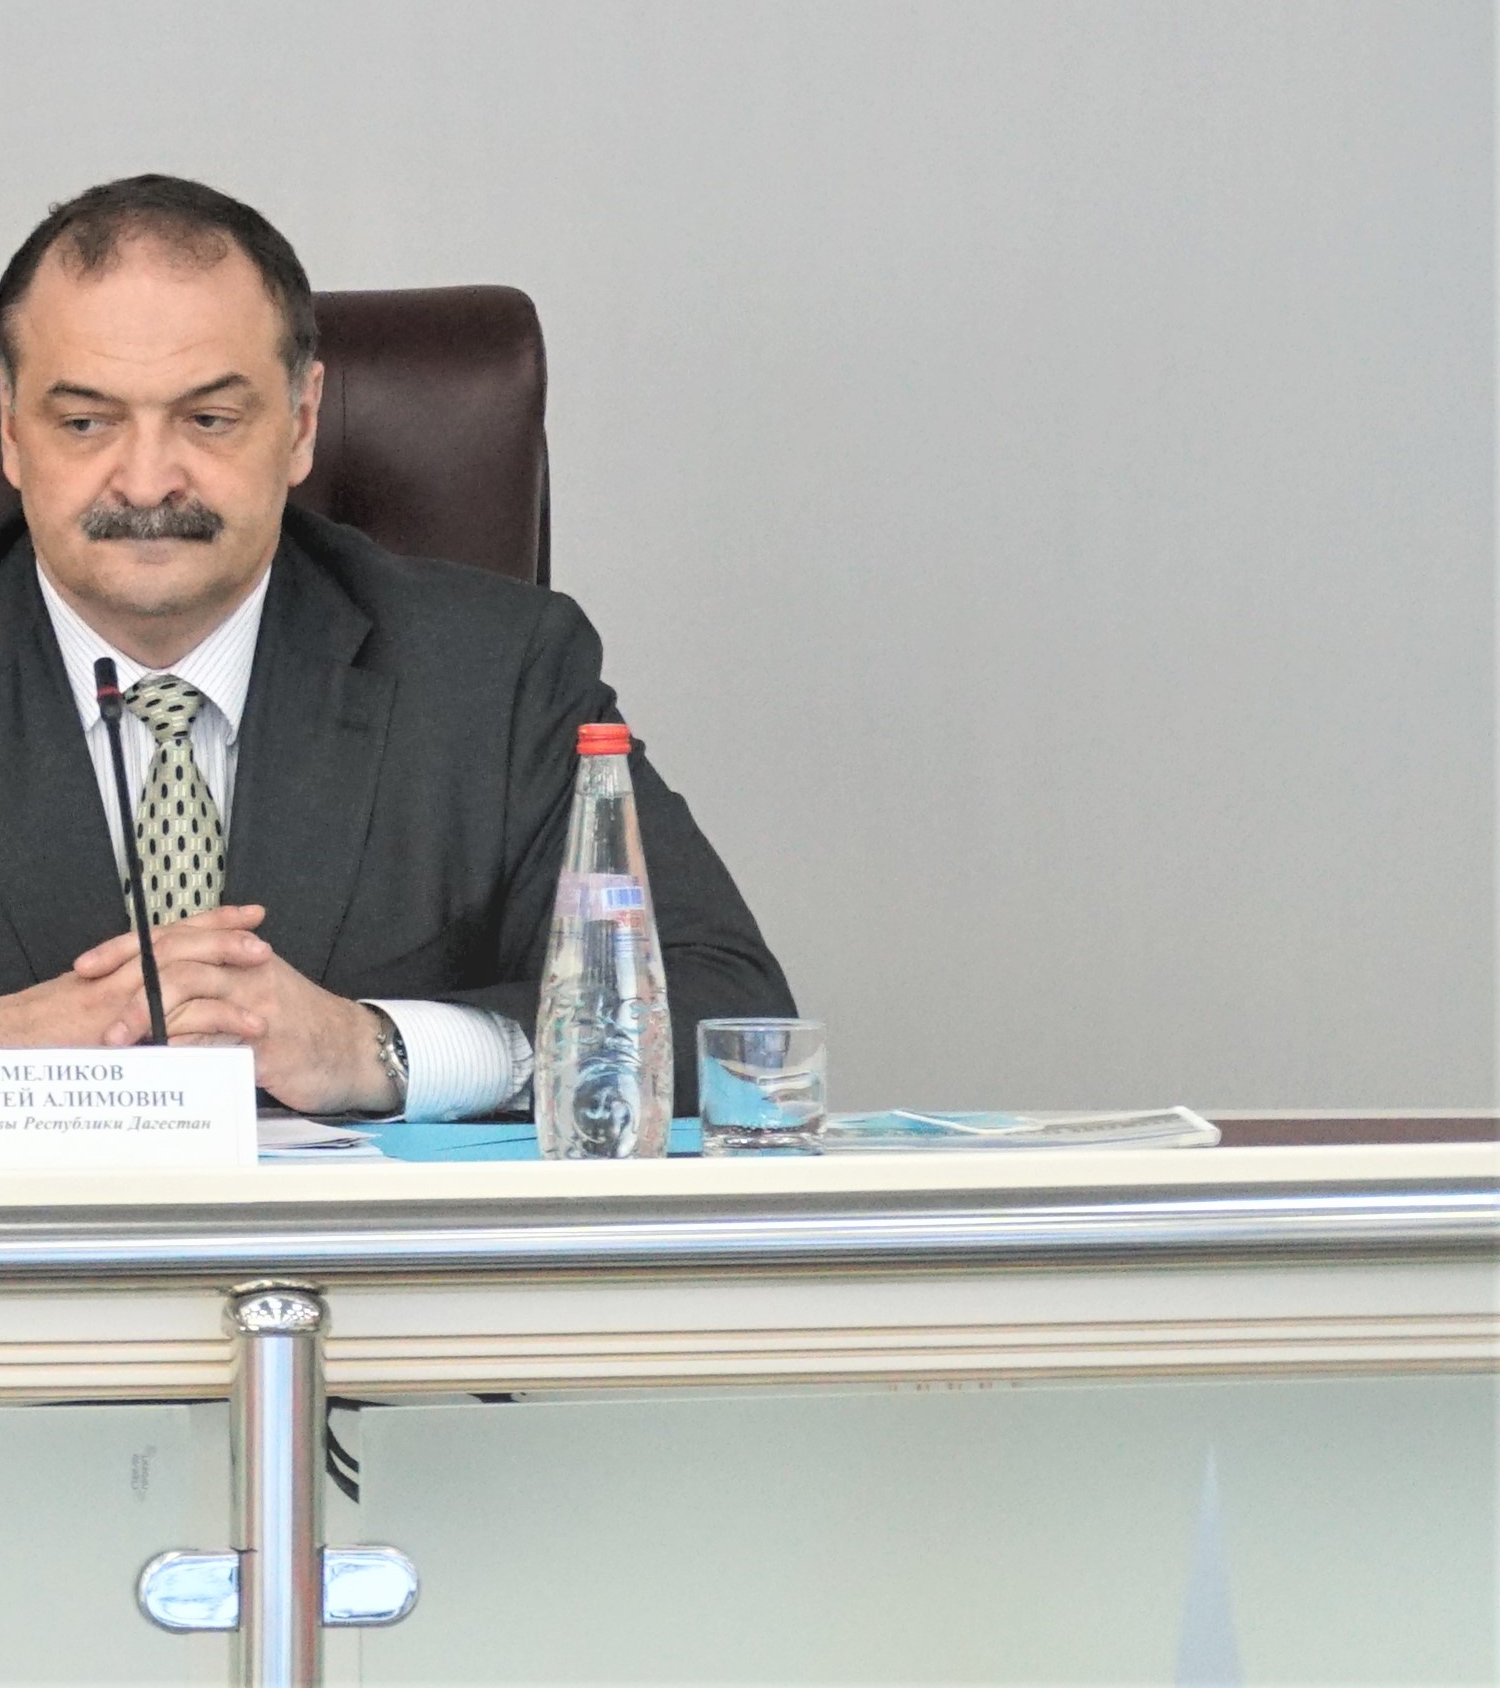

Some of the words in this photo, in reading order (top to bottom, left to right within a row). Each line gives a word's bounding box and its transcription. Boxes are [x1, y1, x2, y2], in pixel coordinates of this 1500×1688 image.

[0, 1064, 125, 1082] МЕЛИКОВ
[43, 1090, 185, 1108] АЛИМОВИЧ
[23, 1115, 124, 1134] Республики
[127, 1116, 212, 1133] Дагестан
